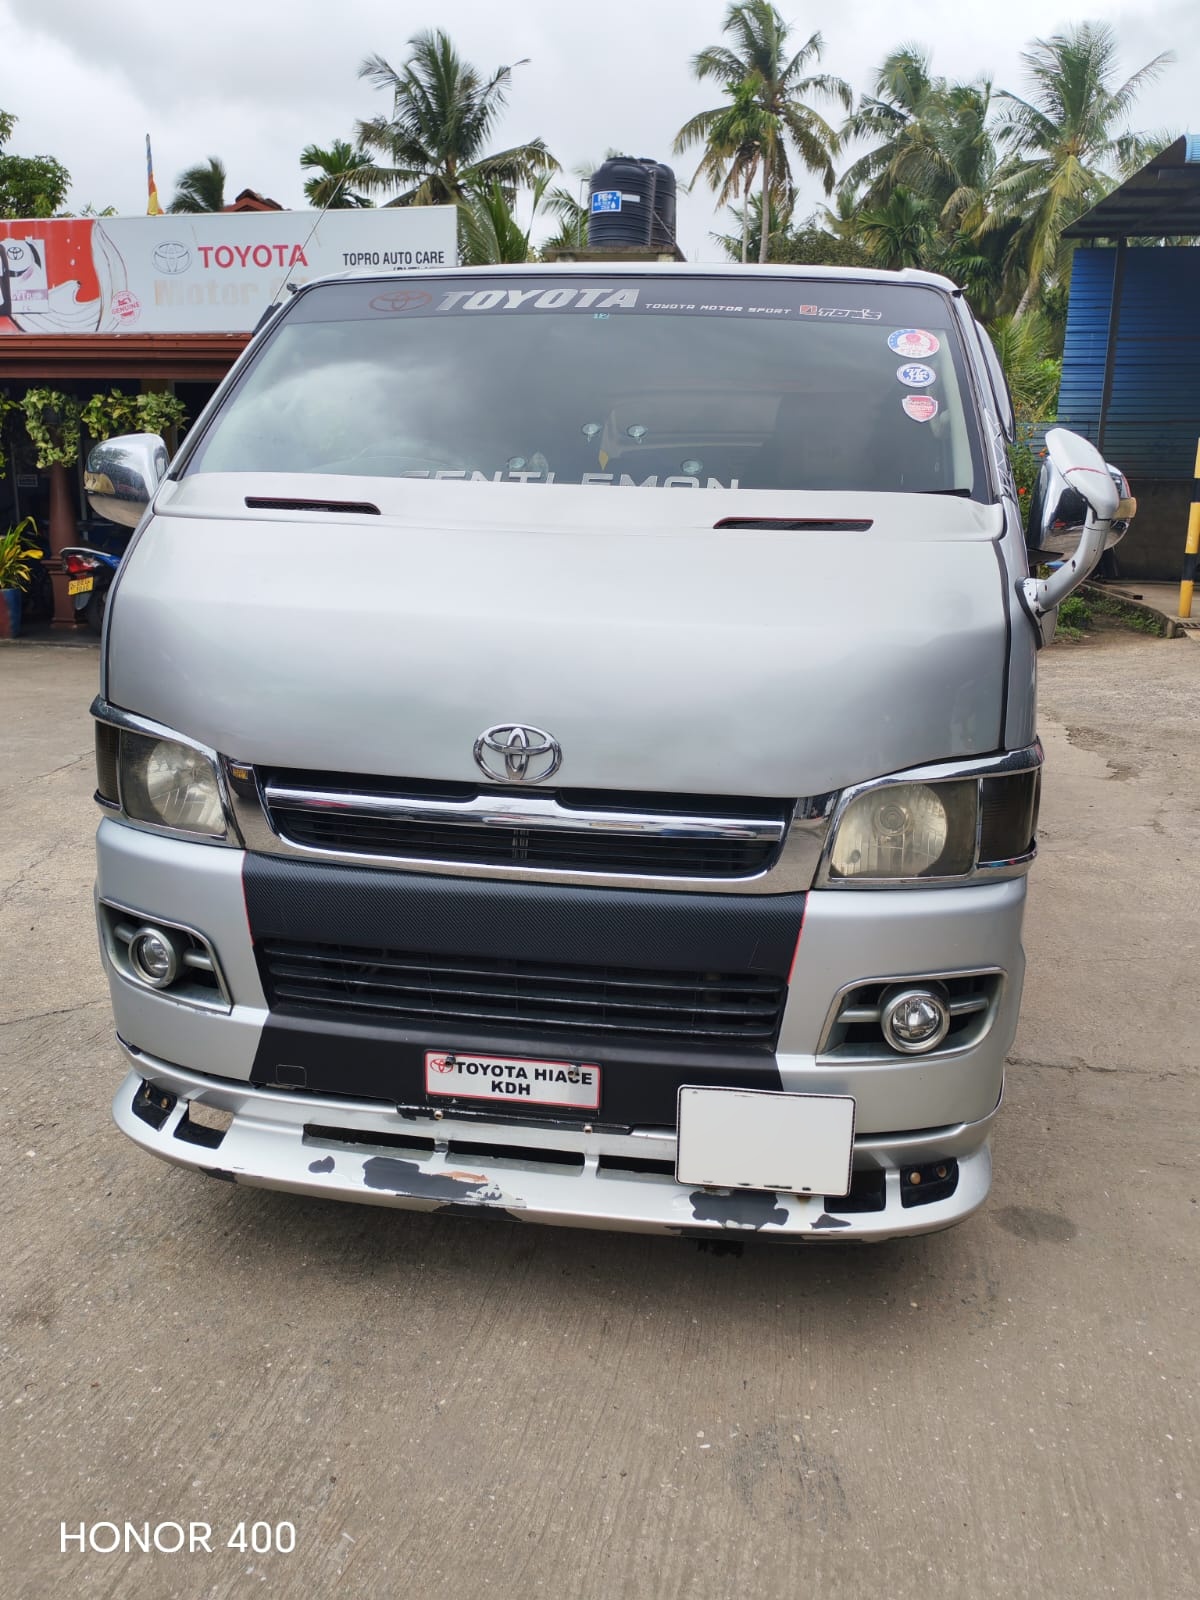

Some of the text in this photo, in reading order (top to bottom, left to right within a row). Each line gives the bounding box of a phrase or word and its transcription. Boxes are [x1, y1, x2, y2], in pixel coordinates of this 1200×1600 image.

[198, 244, 309, 269] TOYOTA
[342, 251, 445, 266] TOPRO AUTO CARE
[435, 288, 641, 311] TOYOTA
[111, 301, 141, 315] GENUINE
[699, 304, 744, 313] MOTOR
[747, 306, 793, 315] SPORT
[456, 1061, 593, 1085] TOYOTA HIACE
[491, 1080, 531, 1096] KDH
